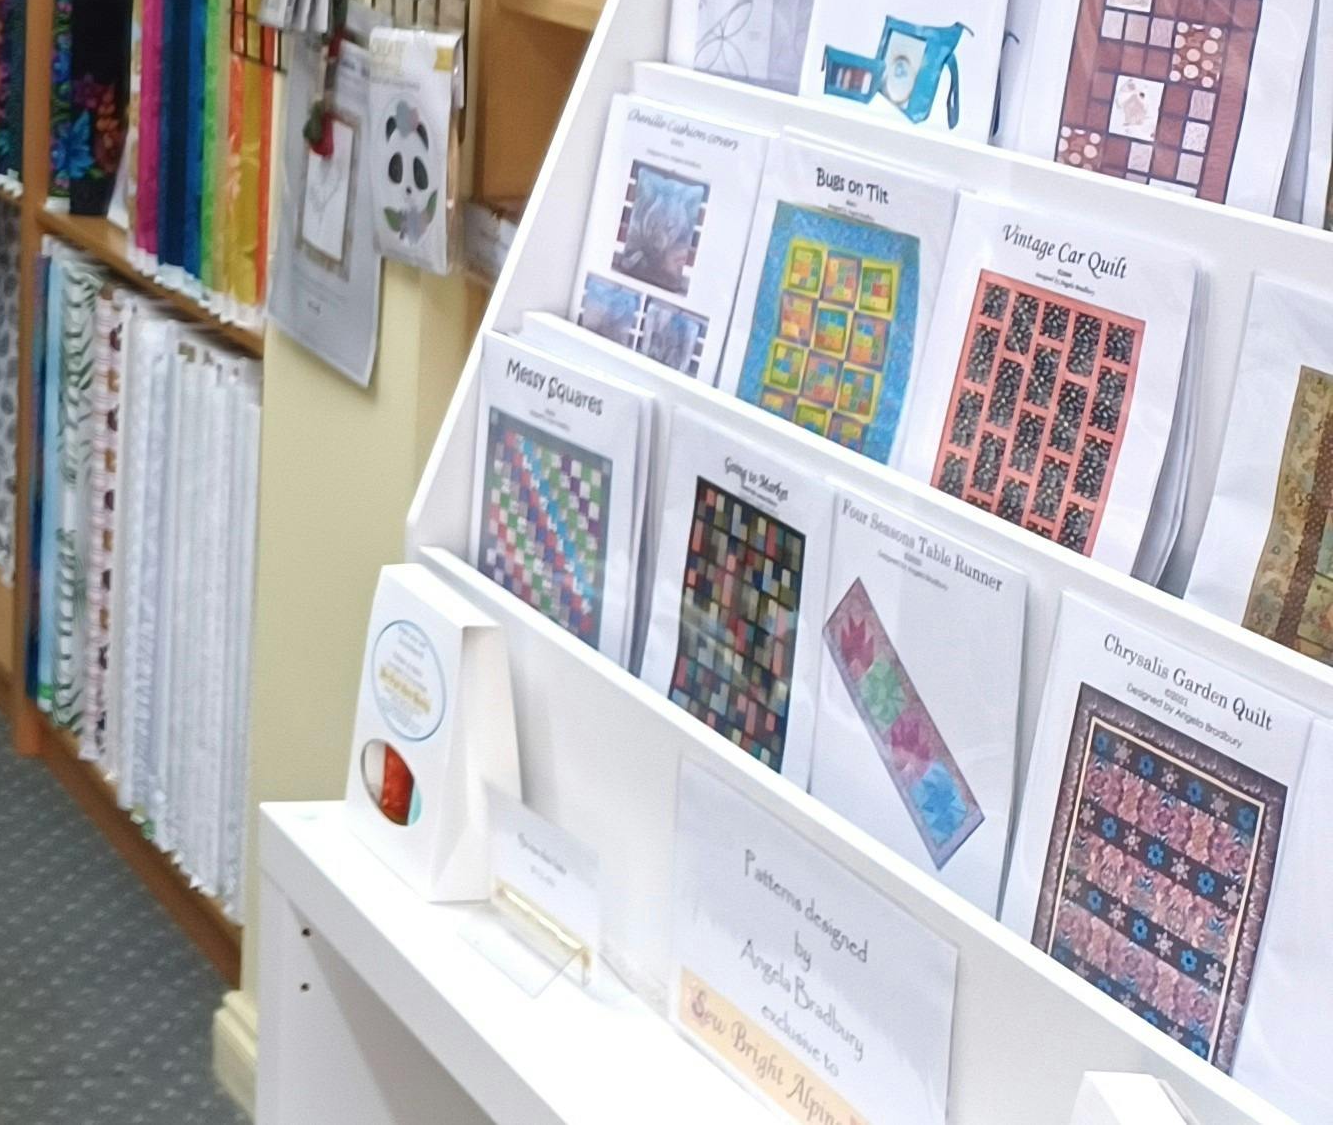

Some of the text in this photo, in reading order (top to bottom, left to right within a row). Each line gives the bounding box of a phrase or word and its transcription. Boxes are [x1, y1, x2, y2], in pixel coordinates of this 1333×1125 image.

[816, 167, 889, 204] Bugs on Tilt
[1003, 224, 1127, 279] Vintage Car Quilt
[506, 358, 603, 416] Messy Squares
[843, 498, 869, 525] Four
[869, 512, 915, 549] Seasons
[918, 536, 952, 567] Table
[954, 554, 1003, 592] Runner
[1104, 633, 1273, 731] Chrysalis Garden Quilt
[1126, 682, 1243, 749] Designed by Angela Bradbury
[745, 849, 868, 963] Patterns designed
[794, 930, 811, 972] by
[740, 938, 864, 1062] Angela Bradbury
[691, 989, 842, 1125] Sew Bright Alpin
[761, 1005, 840, 1077] exclusive to
